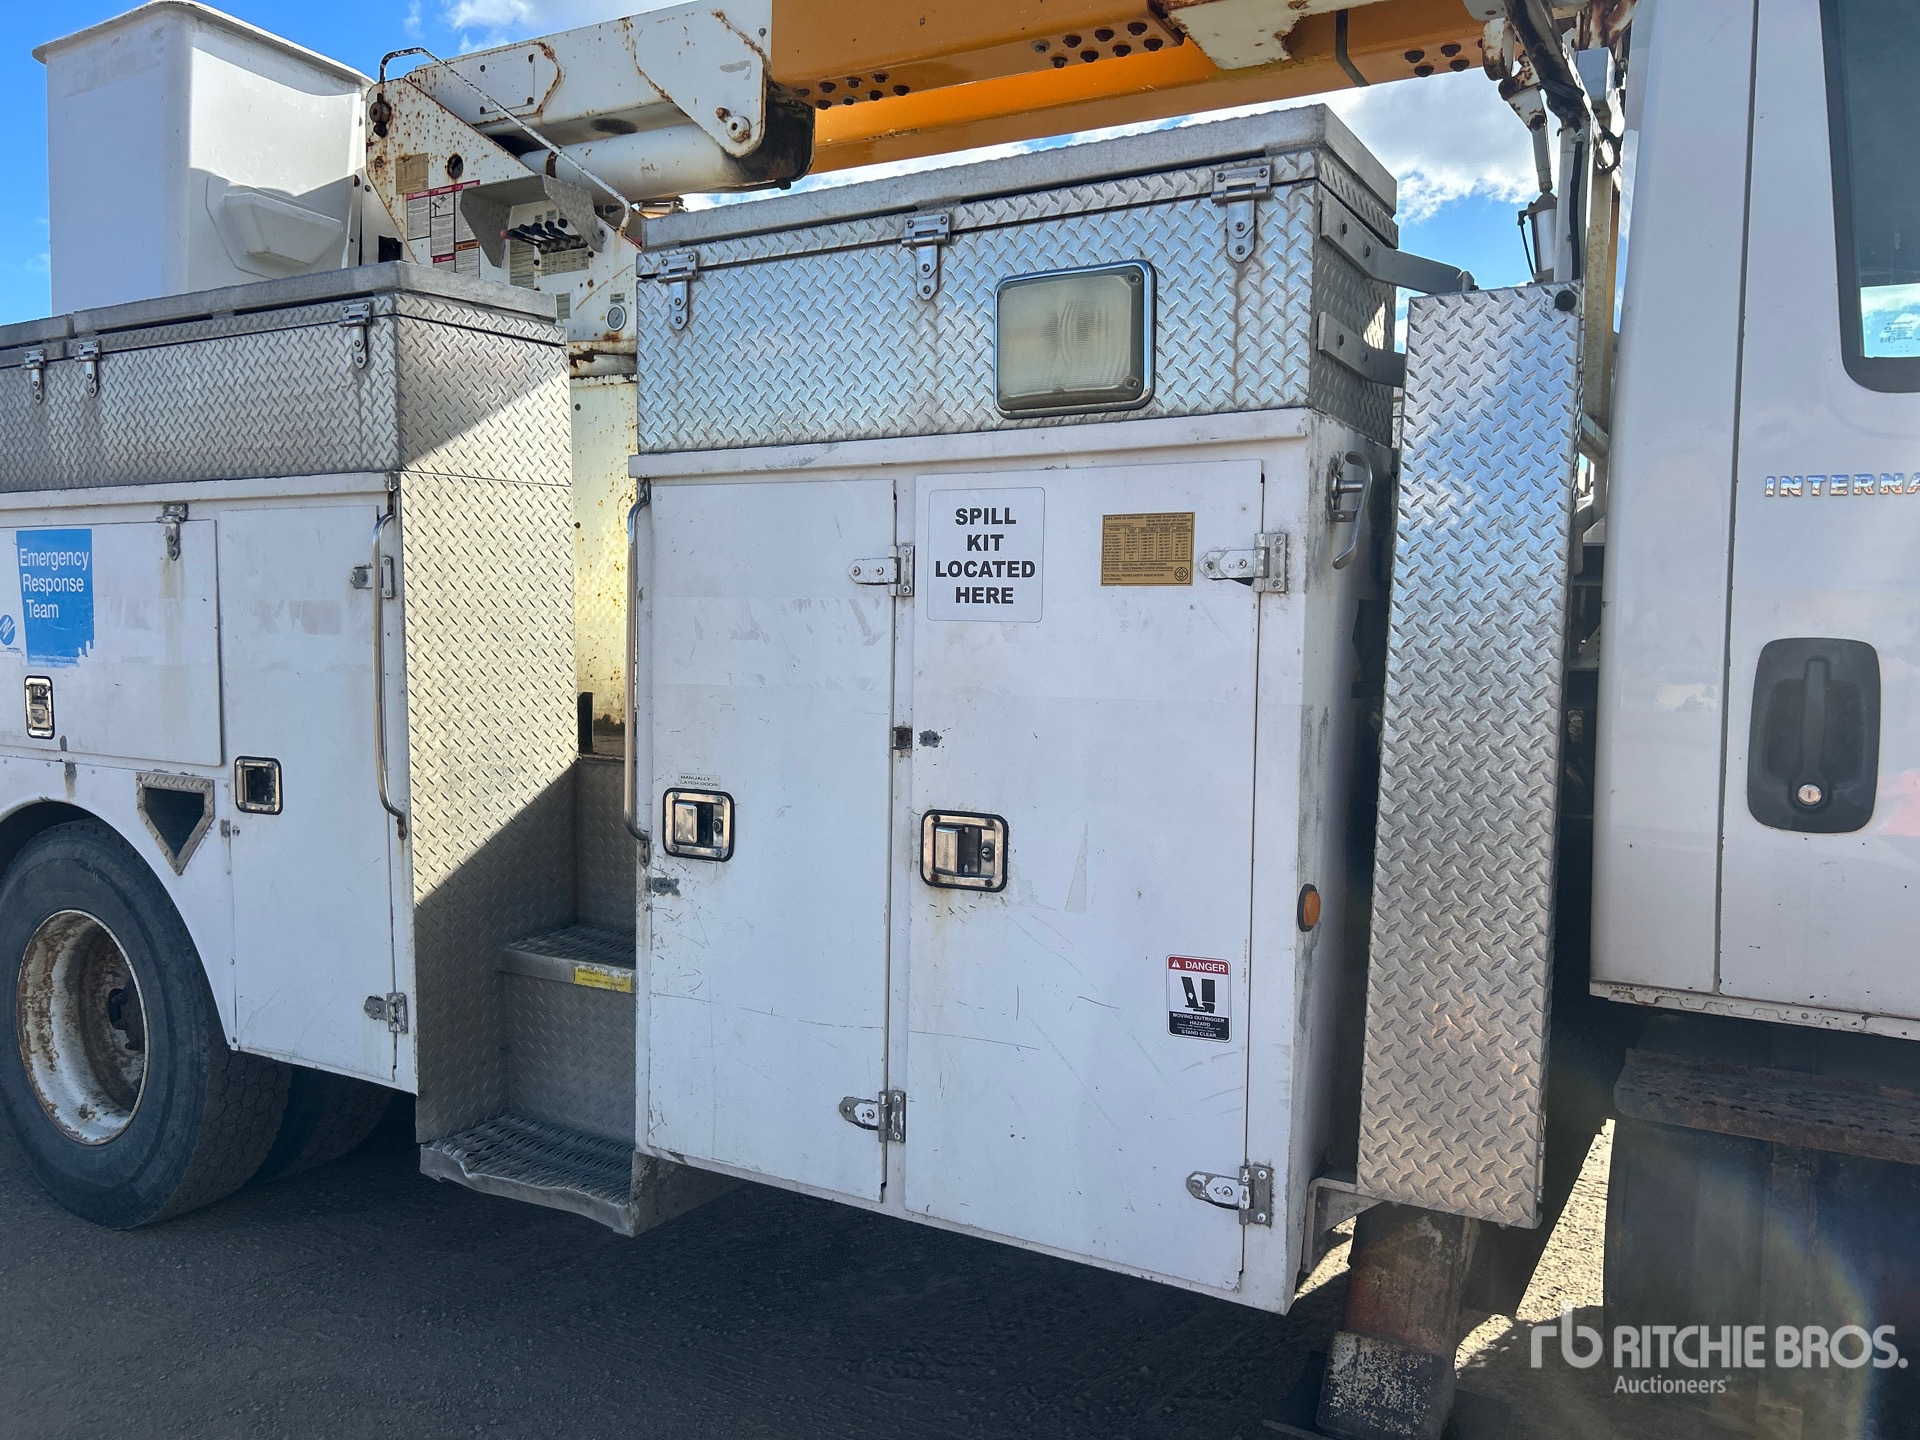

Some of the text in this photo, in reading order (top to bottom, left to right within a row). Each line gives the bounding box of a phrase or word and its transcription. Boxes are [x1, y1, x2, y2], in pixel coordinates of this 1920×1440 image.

[955, 507, 1017, 525] SPILL
[966, 534, 1004, 551] KIT
[20, 548, 89, 571] Emergency
[935, 560, 1036, 578] LOCATED
[22, 573, 84, 596] Response
[955, 586, 1014, 604] HERE
[26, 599, 59, 618] Team
[1185, 960, 1226, 972] DANGER
[1172, 1012, 1225, 1023] MOVING OUTRIGGER
